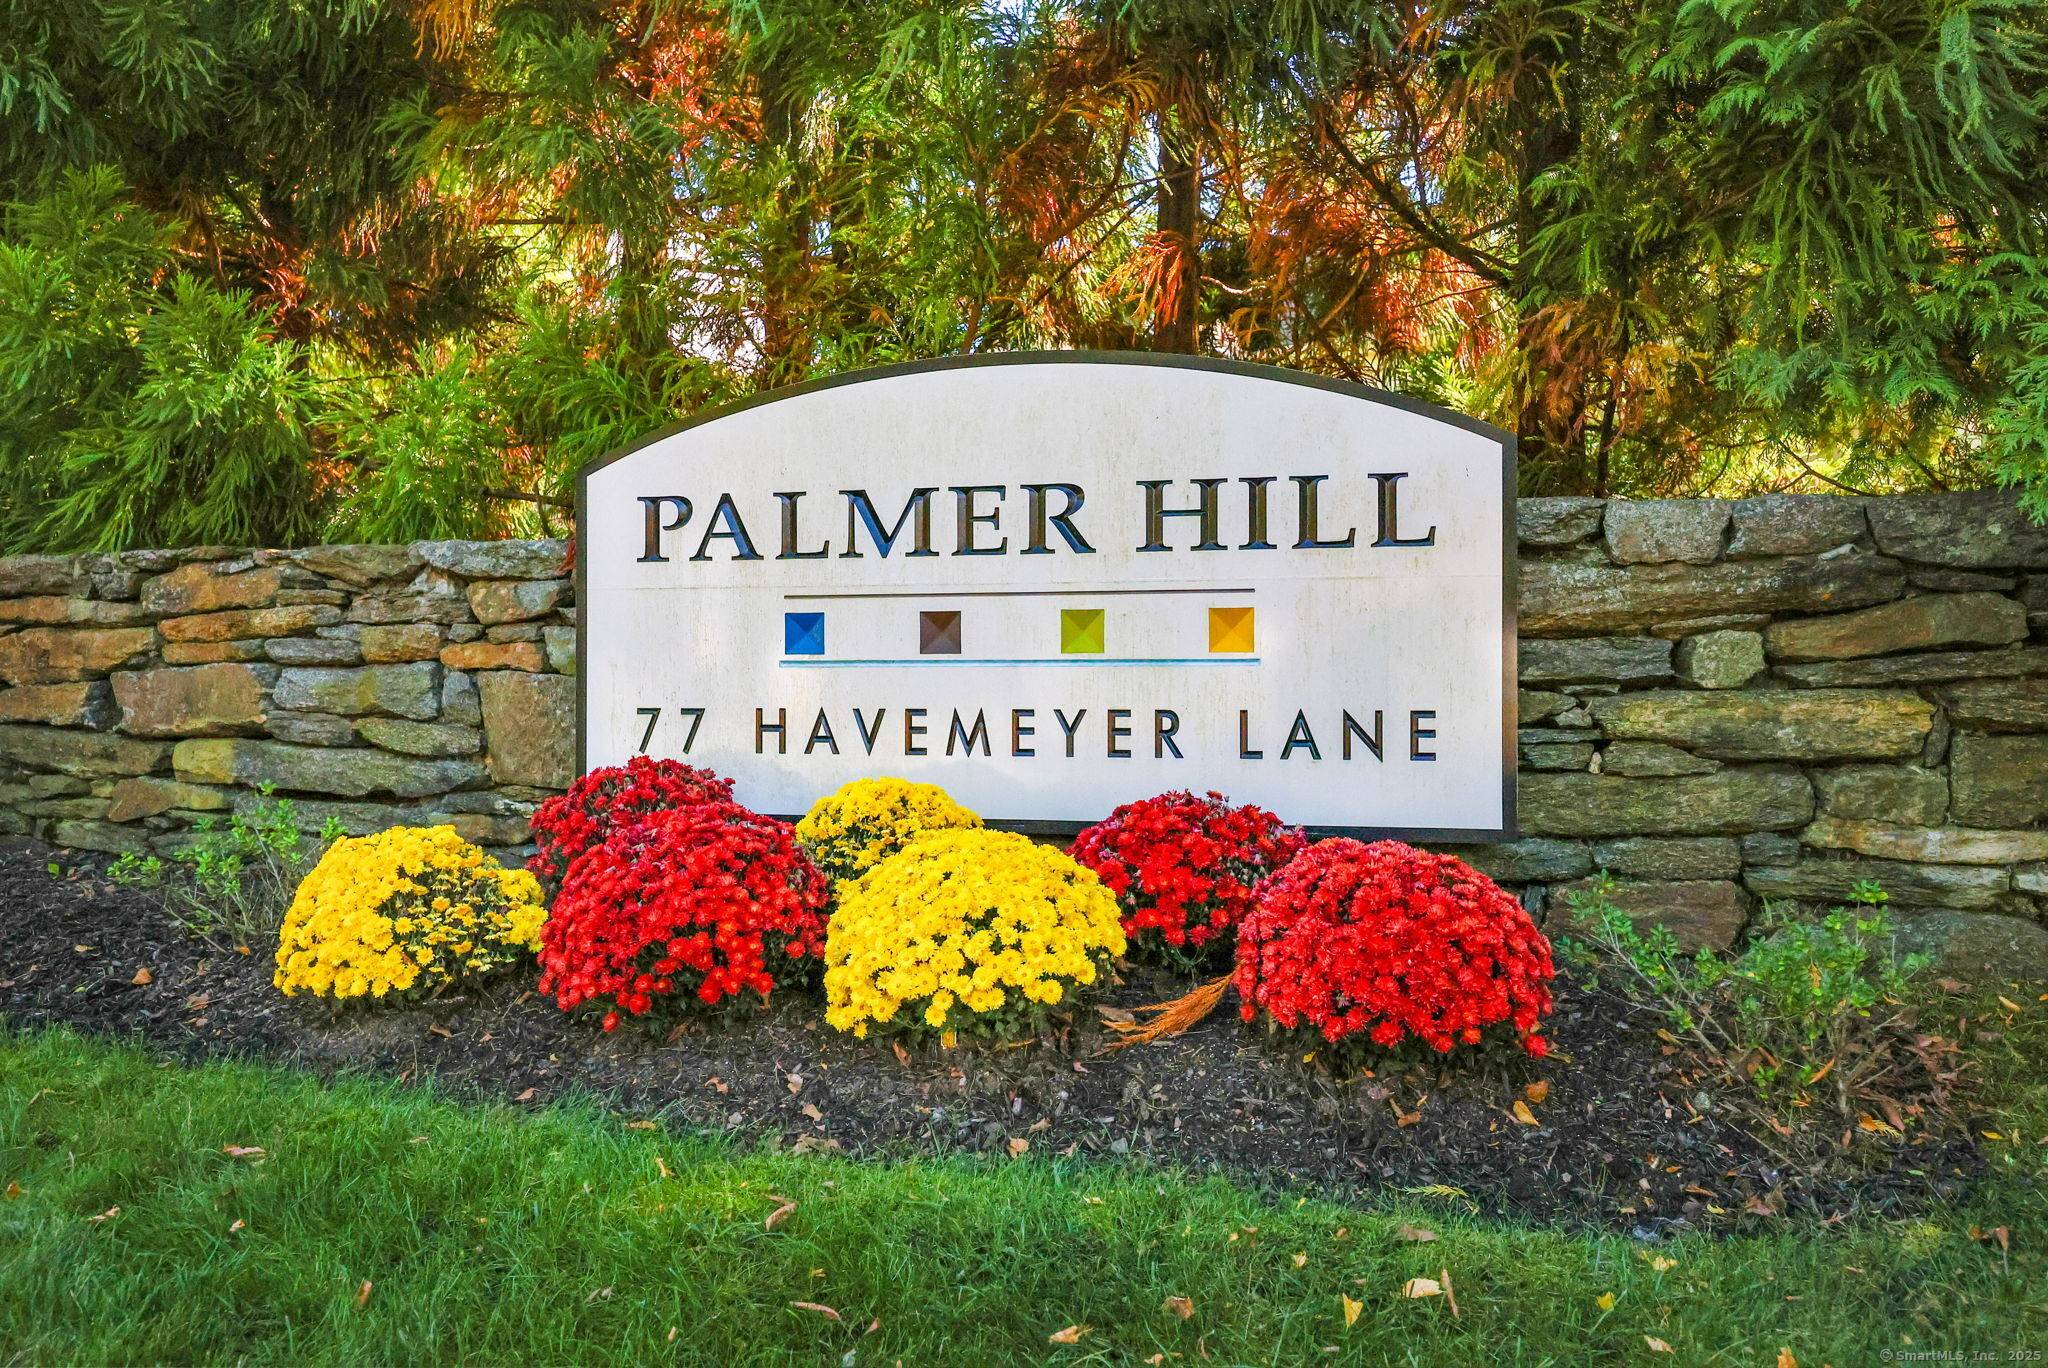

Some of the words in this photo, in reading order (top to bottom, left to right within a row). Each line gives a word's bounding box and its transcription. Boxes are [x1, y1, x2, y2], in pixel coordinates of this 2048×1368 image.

[636, 483, 1096, 563] PALMER
[1136, 472, 1436, 552] HILL
[635, 707, 706, 754] 77
[755, 707, 1181, 759] HAVEMEYER
[1239, 708, 1437, 762] LANE
